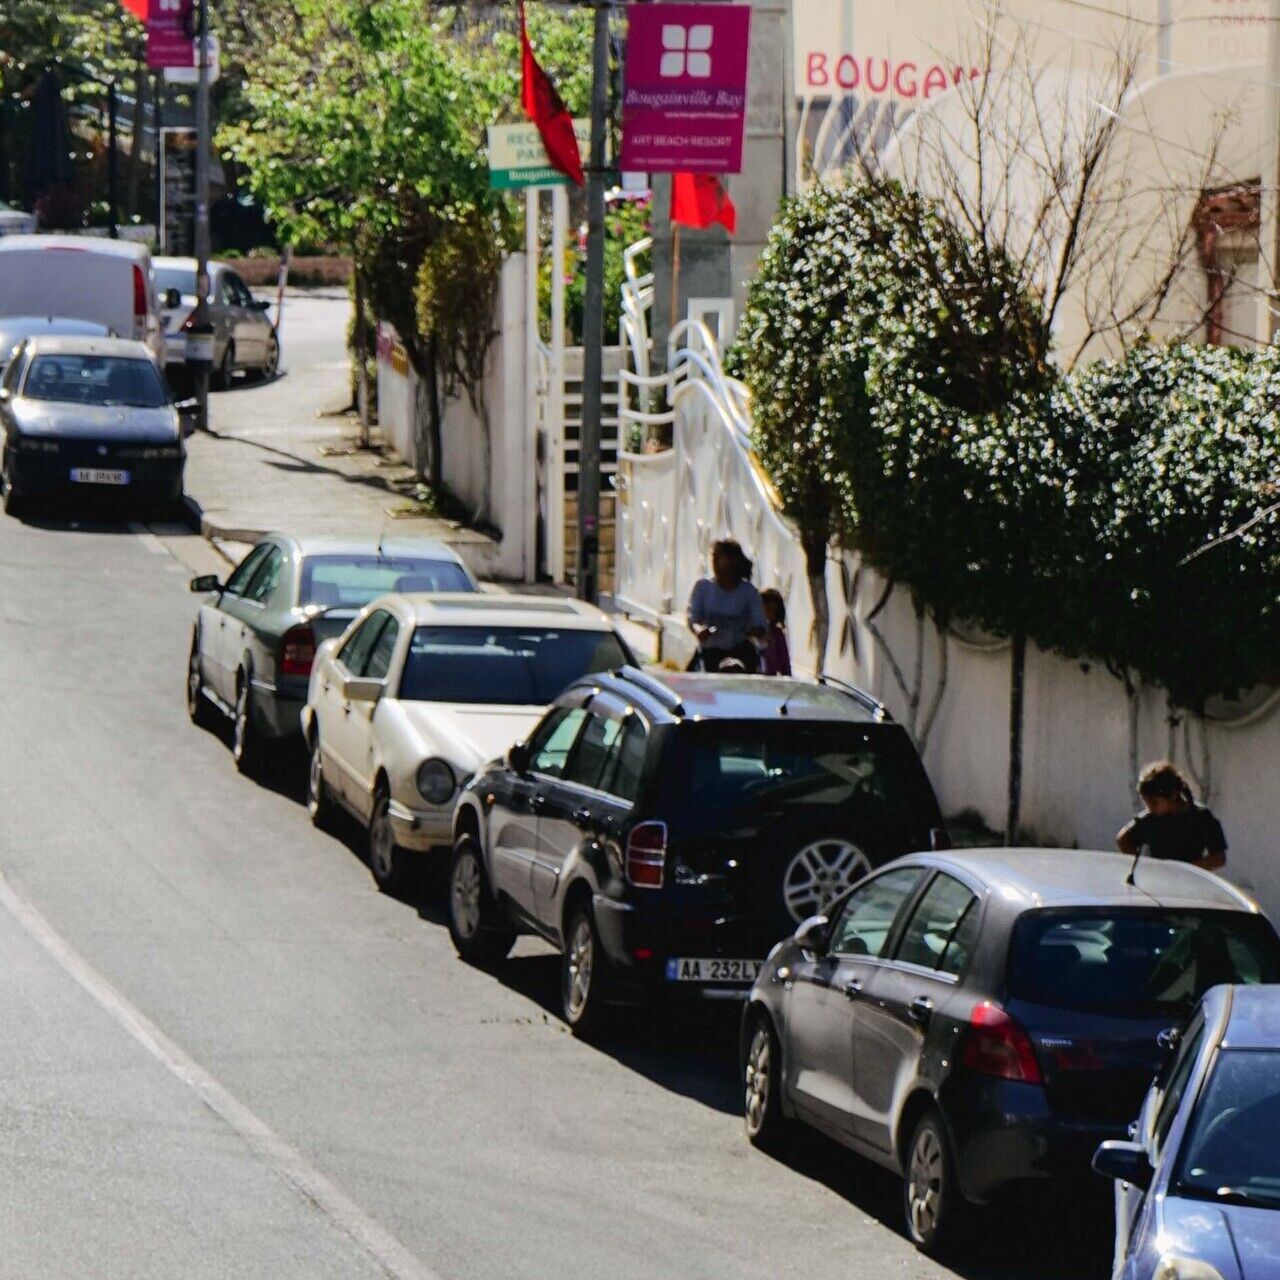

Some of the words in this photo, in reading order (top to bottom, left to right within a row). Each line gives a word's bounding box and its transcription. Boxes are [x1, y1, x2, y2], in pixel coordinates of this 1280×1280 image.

[716, 89, 744, 109] Bay
[653, 135, 689, 147] BEACH
[691, 136, 732, 148] RESORT
[681, 960, 701, 978] AA
